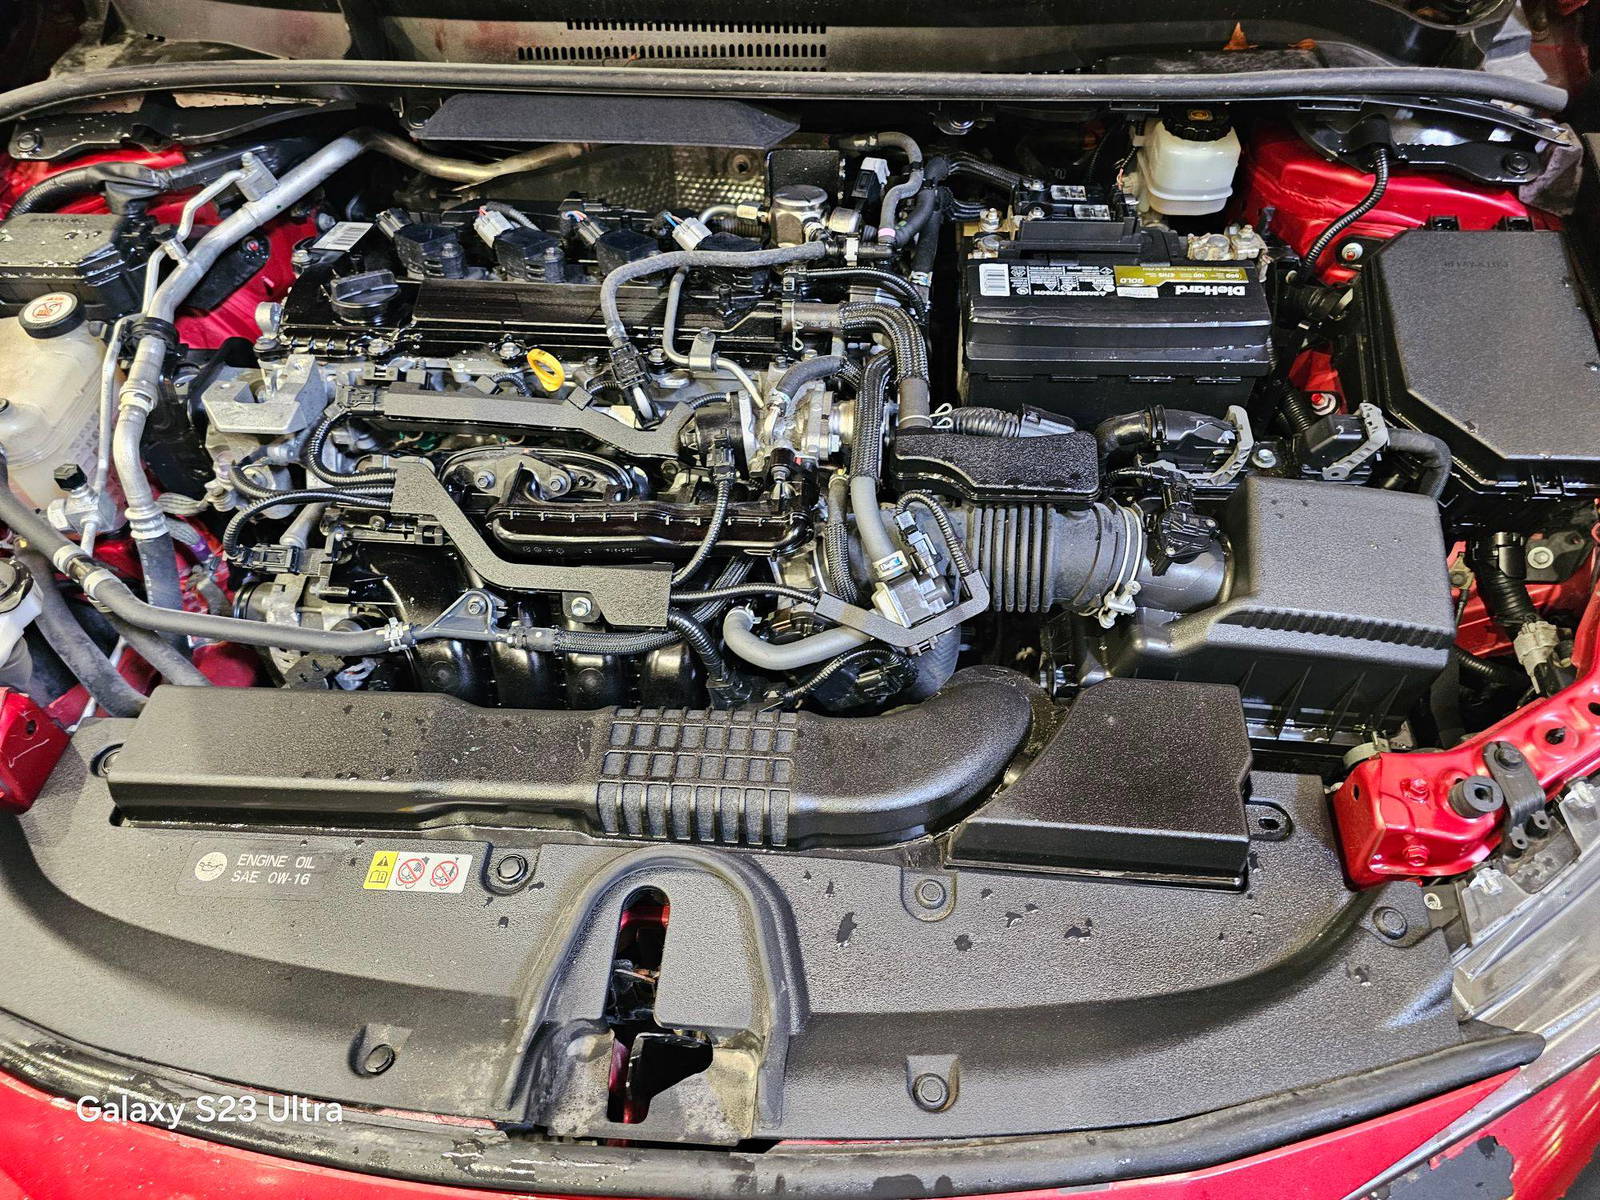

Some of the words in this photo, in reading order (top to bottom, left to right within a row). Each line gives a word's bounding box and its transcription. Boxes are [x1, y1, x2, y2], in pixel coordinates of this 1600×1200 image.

[1175, 285, 1246, 296] DieHard
[236, 853, 289, 868] ENGINE
[295, 856, 316, 869] OIL
[231, 870, 260, 884] SAE
[268, 871, 310, 885] 0W-16
